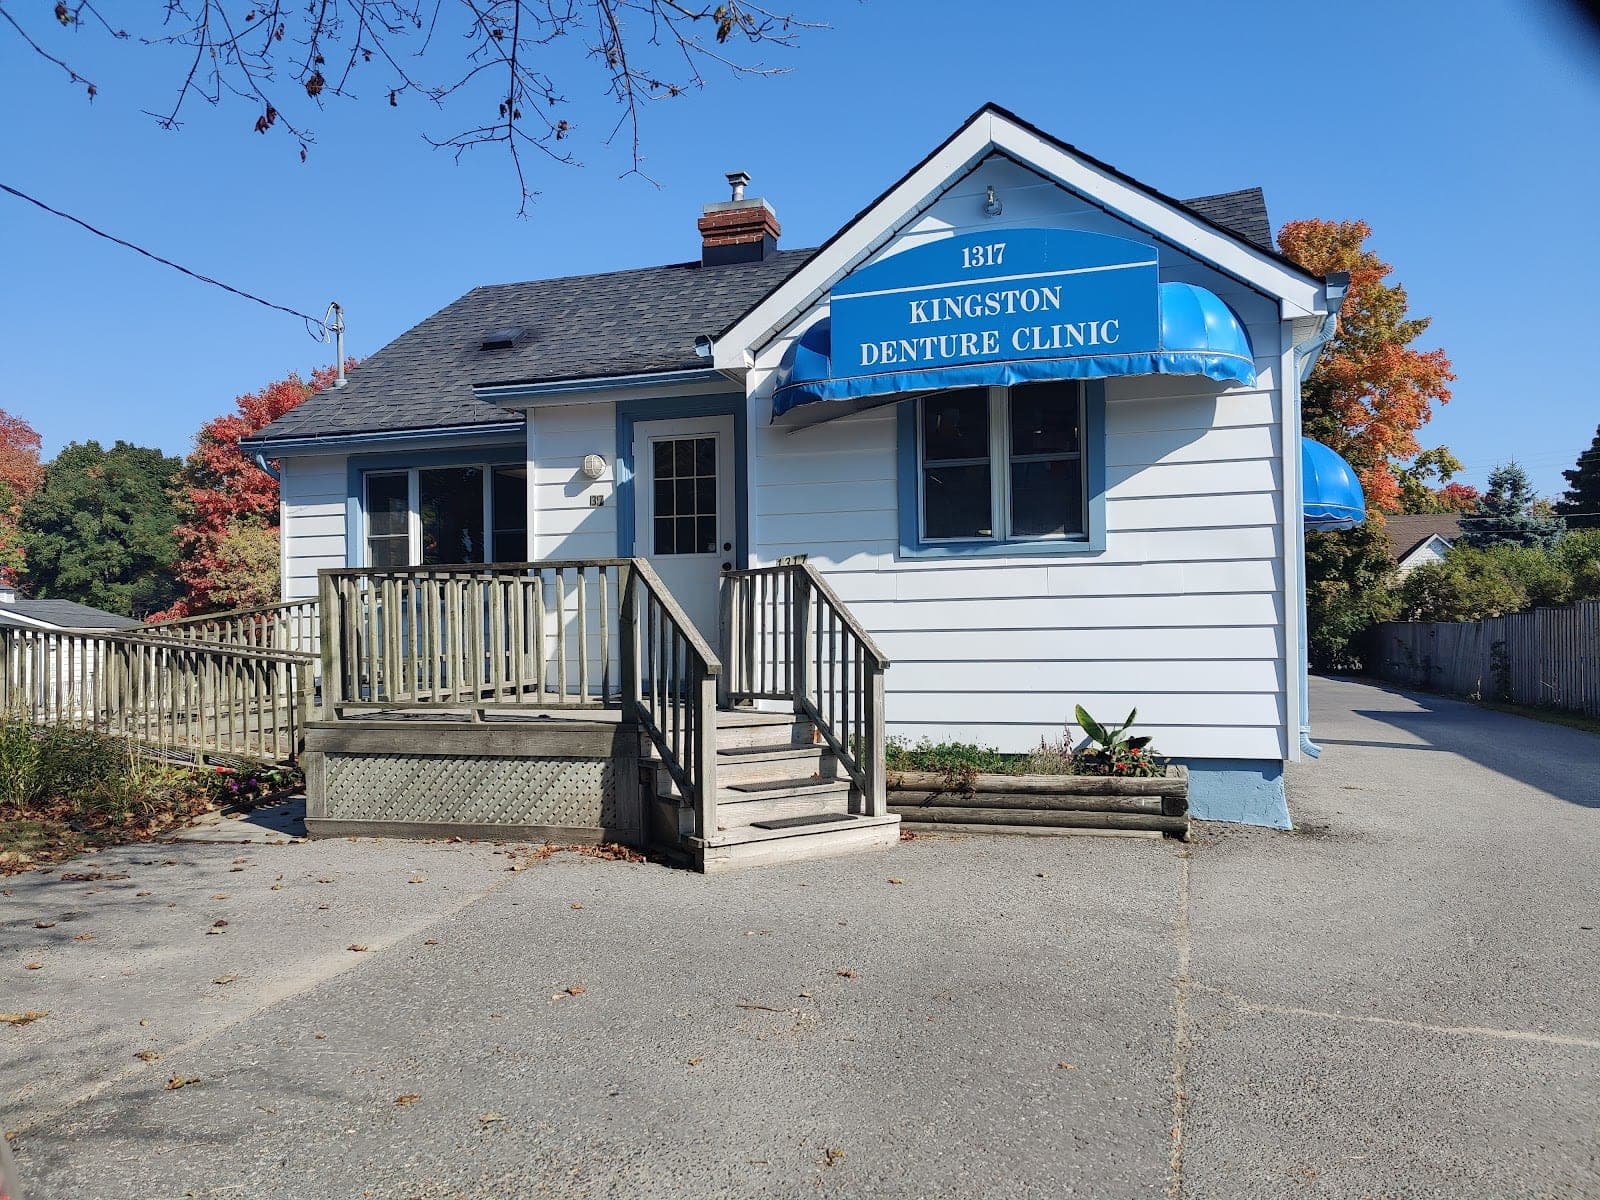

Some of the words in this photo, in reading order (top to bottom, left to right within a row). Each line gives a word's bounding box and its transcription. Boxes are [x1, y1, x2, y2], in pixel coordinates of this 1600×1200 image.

[962, 242, 1006, 268] 1317
[909, 286, 1062, 324] KINGSTON
[860, 334, 1000, 366] DENTURE
[1012, 319, 1120, 354] CLINIC
